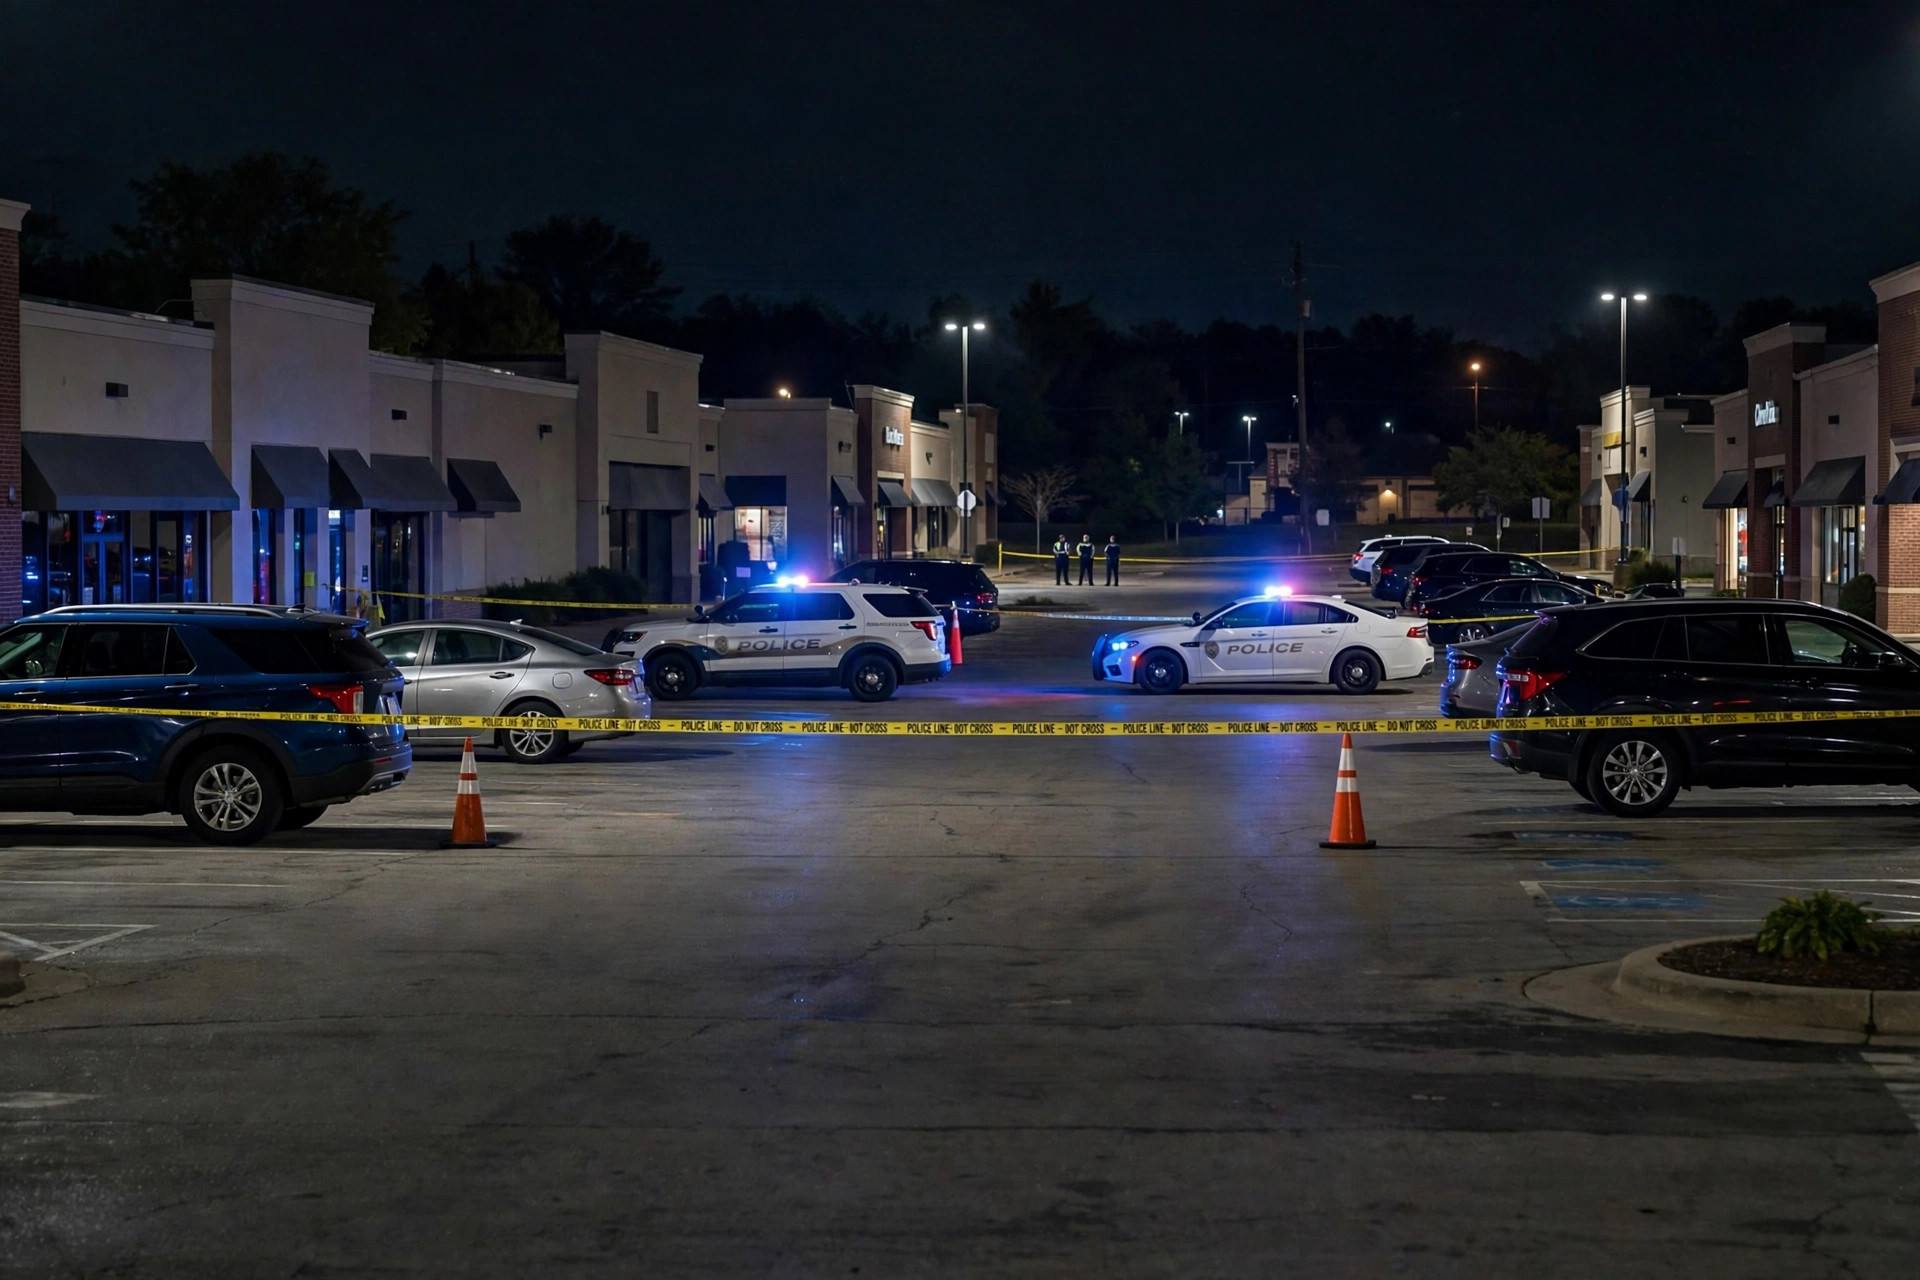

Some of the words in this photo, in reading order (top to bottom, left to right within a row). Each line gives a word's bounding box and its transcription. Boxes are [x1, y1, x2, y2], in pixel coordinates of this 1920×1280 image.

[737, 639, 821, 651] POLICE
[1227, 642, 1304, 655] POLICE
[578, 719, 602, 728] POLICE
[604, 720, 618, 729] LINE
[639, 720, 660, 730] CROSS
[681, 721, 705, 730] POLICE
[708, 722, 722, 731] LINE
[760, 722, 782, 732] CROSS
[802, 722, 826, 732] POLICE
[865, 724, 887, 733] CROSS
[907, 724, 932, 733] POLICE
[970, 724, 993, 734] CROSS
[1012, 724, 1037, 734] POLICE
[1040, 724, 1054, 734] LINE
[1081, 724, 1104, 734] CROSS
[1123, 724, 1147, 734] POLICE
[1188, 724, 1208, 734] CROSS
[1228, 723, 1252, 733] POLICE
[1255, 723, 1270, 733] LINE
[1296, 722, 1318, 732] CROSS
[1336, 721, 1360, 732] POLICE
[1362, 721, 1377, 731] LINE
[1387, 720, 1397, 730] DO
[1399, 720, 1413, 730] NOT
[1416, 720, 1437, 730] CROSS
[1456, 719, 1479, 729] POLICE
[1545, 718, 1570, 728] POLICE
